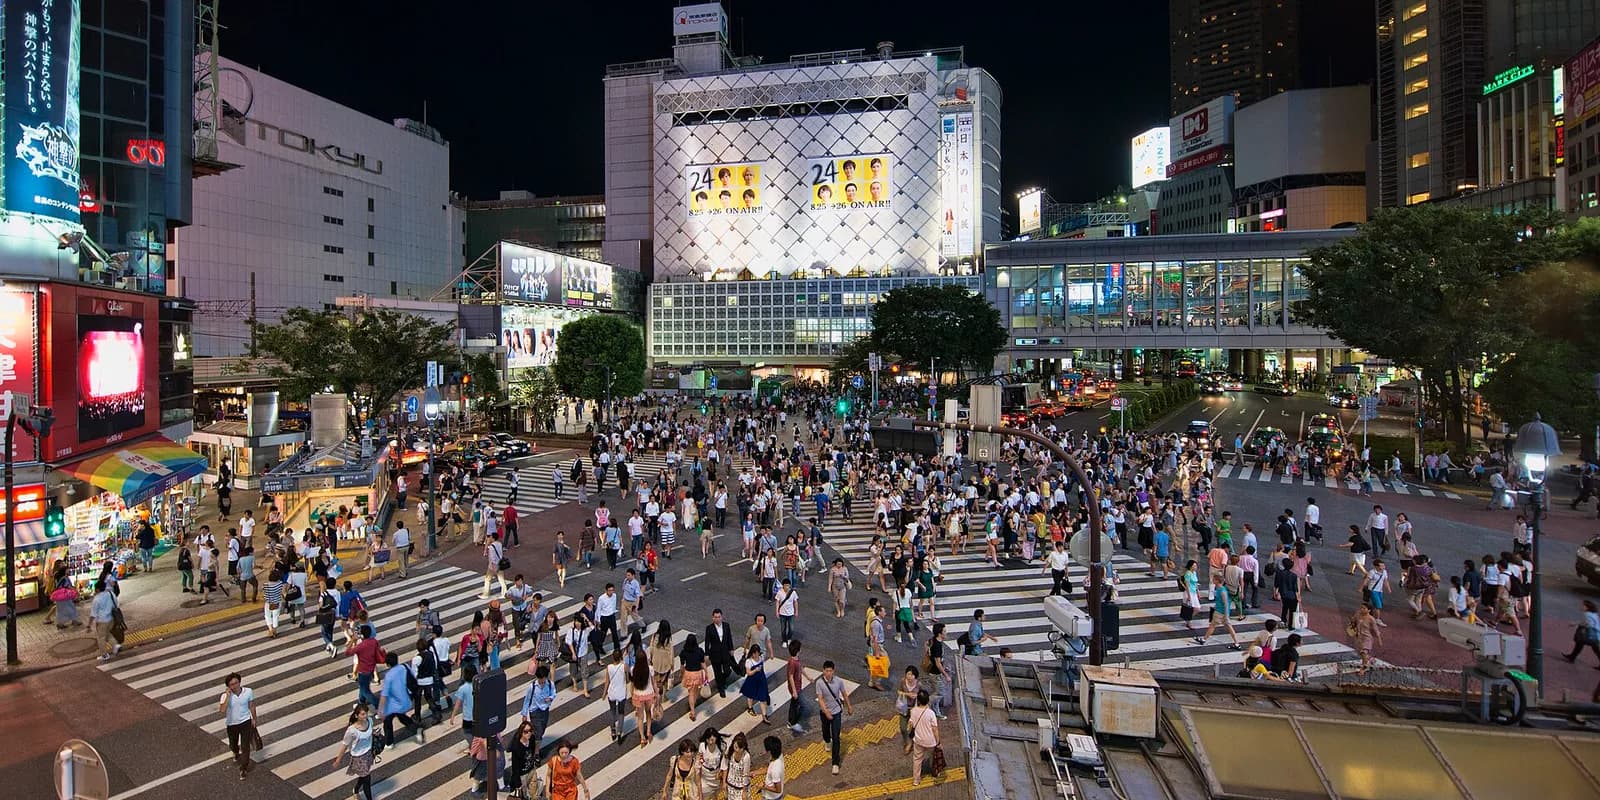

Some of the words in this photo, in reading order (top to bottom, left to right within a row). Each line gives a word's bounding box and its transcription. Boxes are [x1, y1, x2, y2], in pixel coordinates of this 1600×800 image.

[1483, 76, 1509, 92] MARK
[1510, 64, 1535, 80] CITY
[246, 118, 383, 175] TOKYU
[690, 167, 716, 192] 24
[811, 160, 839, 186] 24
[725, 207, 739, 215] ON
[850, 201, 865, 209] ON
